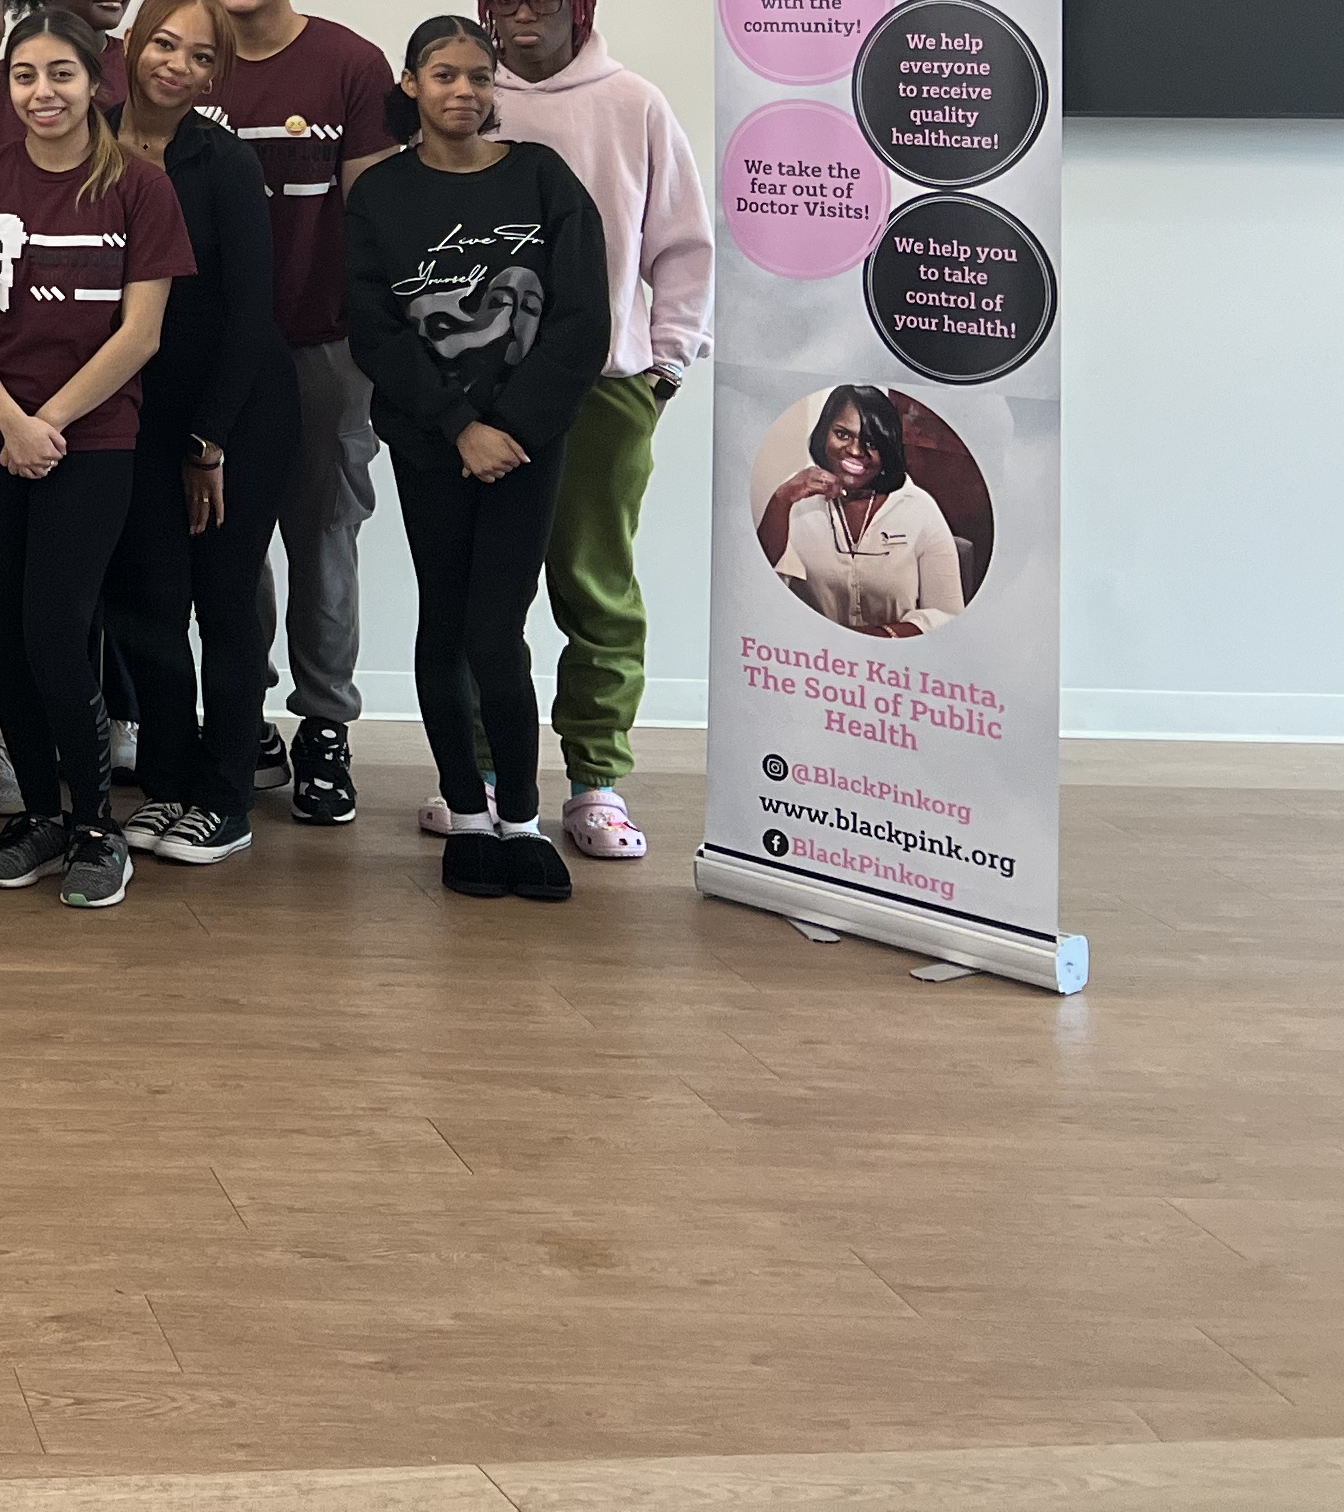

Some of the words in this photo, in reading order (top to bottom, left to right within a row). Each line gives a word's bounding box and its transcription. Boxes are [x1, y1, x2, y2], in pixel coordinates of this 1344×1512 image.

[744, 18, 860, 37] community!
[906, 34, 935, 49] We
[941, 33, 982, 54] help
[900, 61, 990, 78] everyone
[899, 83, 917, 97] to
[922, 83, 991, 99] receive
[909, 106, 979, 127] quality
[892, 128, 998, 149] healthcare!
[744, 160, 772, 175] We
[778, 161, 821, 177] take
[828, 162, 860, 179] the
[750, 178, 787, 195] fear
[793, 184, 827, 197] out
[833, 183, 854, 198] of
[737, 197, 798, 215] Doctor
[804, 201, 869, 220] Visits!
[427, 223, 497, 254] Live
[894, 237, 924, 254] We
[929, 238, 971, 261] help
[976, 247, 1017, 263] you
[390, 259, 489, 297] Yourself
[919, 265, 938, 280] to
[944, 266, 987, 284] take
[906, 291, 976, 309] control
[982, 294, 1004, 311] of
[894, 315, 938, 330] your
[943, 317, 1015, 338] health!
[741, 636, 858, 678] Founder
[866, 660, 911, 690] Kai
[917, 672, 1004, 714] Ianta,
[744, 664, 797, 694] The
[805, 675, 869, 709] Soul
[874, 693, 903, 717] of
[910, 700, 1004, 741] Public
[825, 708, 920, 751] Health
[791, 764, 970, 825] @BlackPinkorg
[758, 794, 1015, 878] www.blackpink.org
[791, 835, 956, 901] BlackPinkorg
